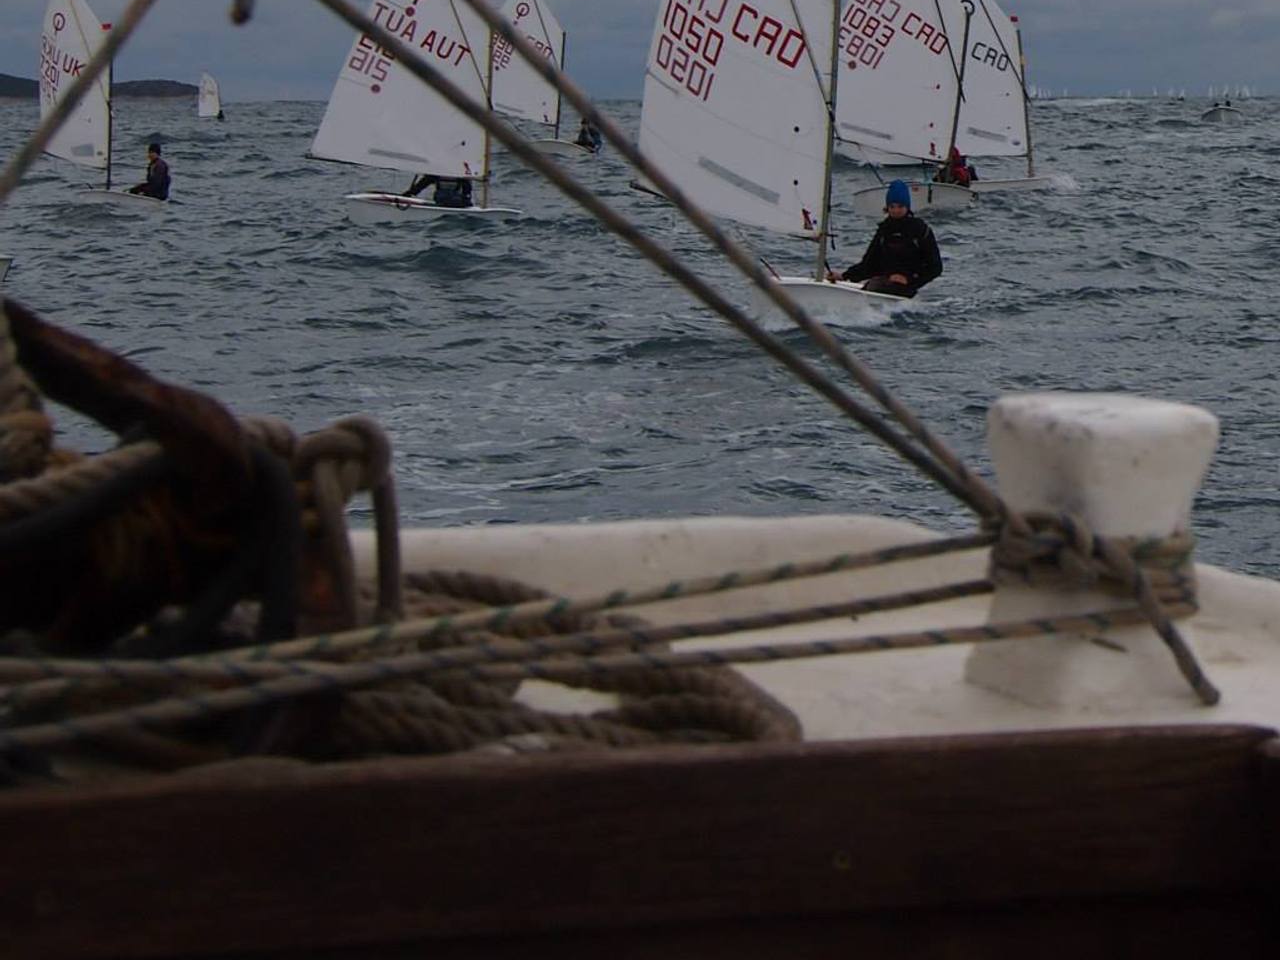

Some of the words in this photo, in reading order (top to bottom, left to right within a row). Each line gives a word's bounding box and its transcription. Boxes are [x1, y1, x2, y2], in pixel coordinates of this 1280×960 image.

[843, 4, 895, 48] 1083
[63, 53, 87, 77] UK
[420, 30, 471, 67] AUT
